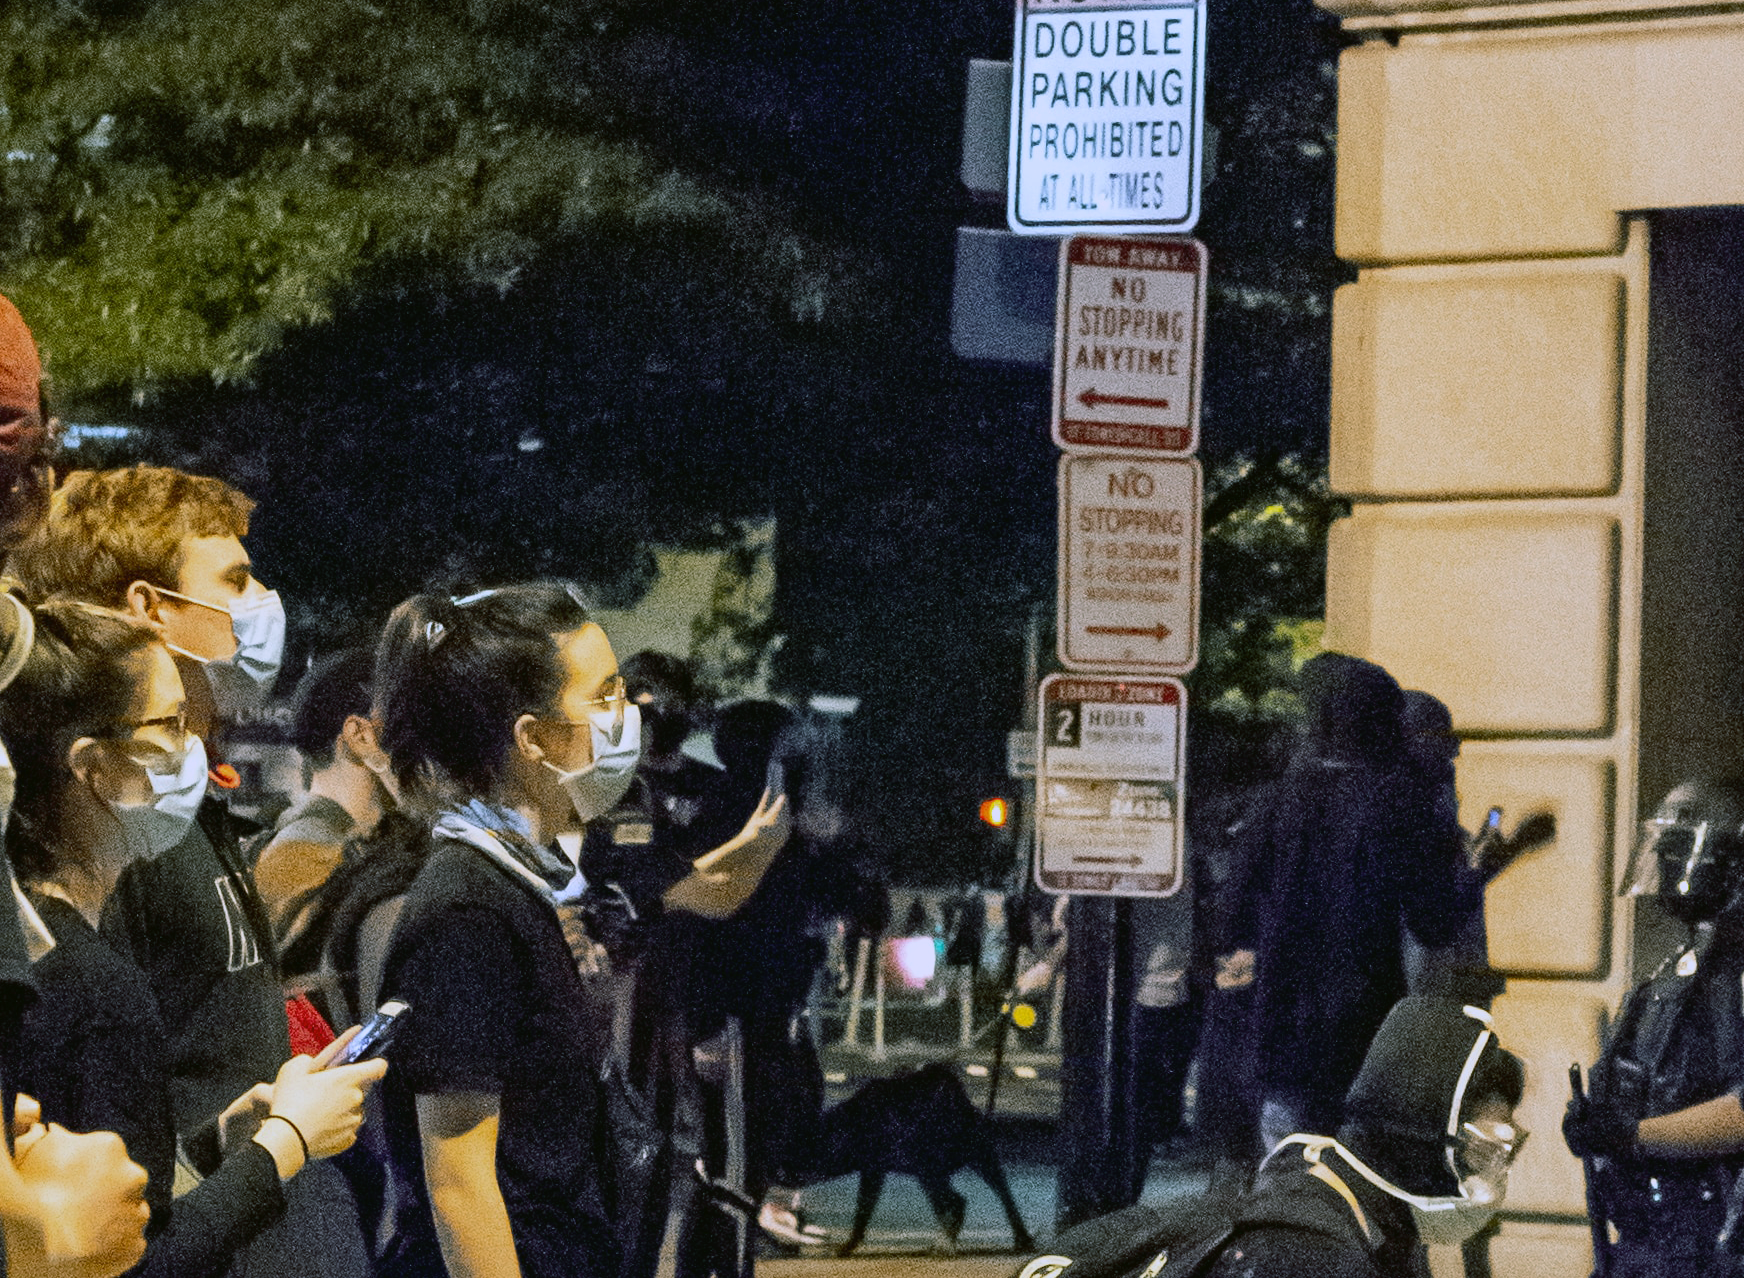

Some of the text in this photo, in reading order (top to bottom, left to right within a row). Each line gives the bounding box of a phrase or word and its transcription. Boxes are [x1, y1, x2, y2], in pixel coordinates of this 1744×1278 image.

[1035, 18, 1182, 58] DOUBLE
[1031, 68, 1183, 108] PARKING
[1029, 120, 1183, 159] PROHIBITED
[1039, 171, 1164, 210] AT ALL TIMES
[1111, 276, 1146, 303] NO
[1078, 305, 1184, 342] STOPPING
[1075, 344, 1179, 376] ANYTIME
[1108, 471, 1155, 499] NO
[1079, 506, 1184, 536] STOPPING
[1055, 709, 1075, 742] 2
[1088, 709, 1146, 727] HOUR
